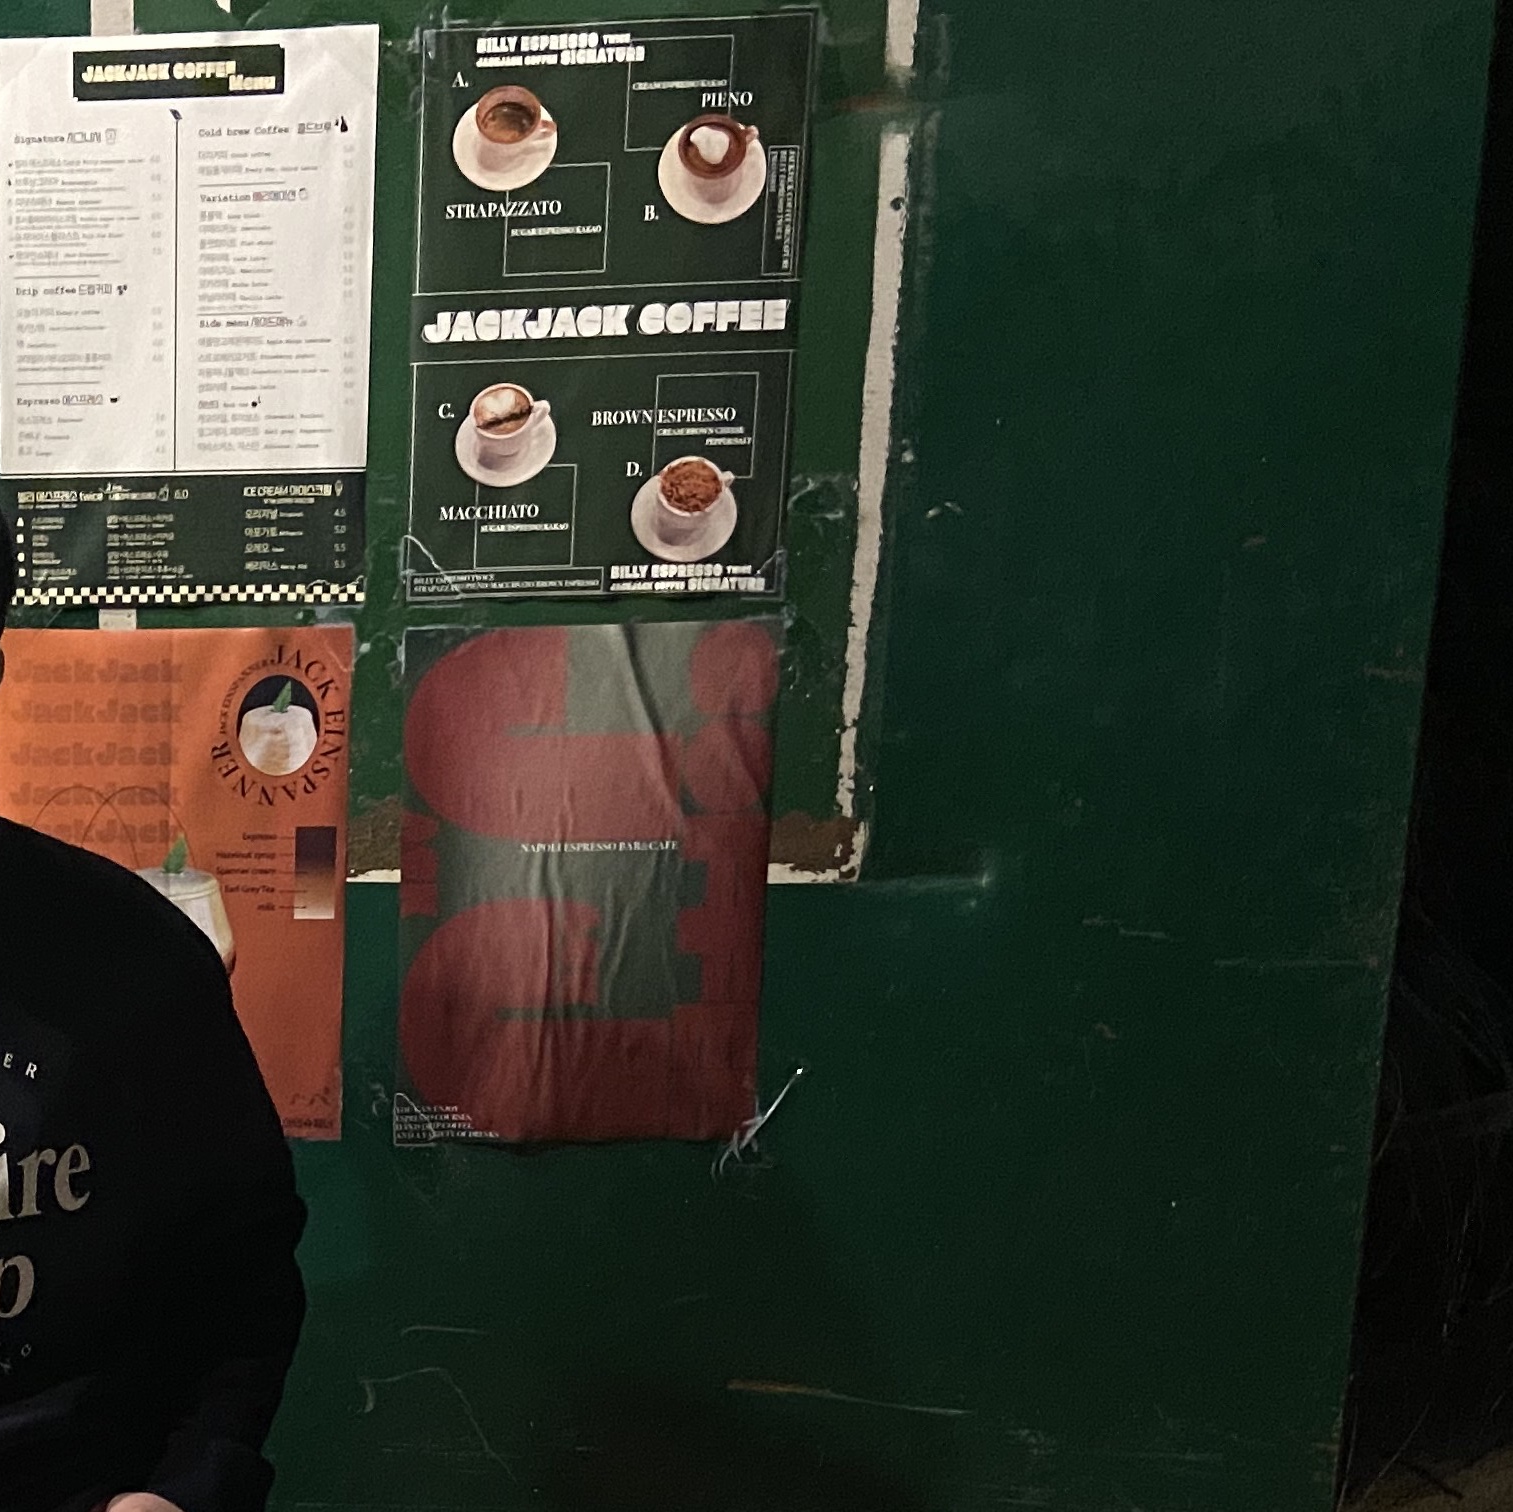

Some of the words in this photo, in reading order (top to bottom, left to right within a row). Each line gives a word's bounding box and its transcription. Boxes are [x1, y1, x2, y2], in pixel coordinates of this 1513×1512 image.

[520, 32, 599, 52] ESPRESSO
[560, 45, 645, 66] SIGNATURE
[81, 63, 170, 84] JACKJACK
[173, 60, 238, 82] COFFEE
[451, 72, 470, 88] A.
[701, 91, 754, 108] PIENO
[14, 134, 65, 146] Signature
[198, 128, 222, 138] Cold
[227, 127, 250, 137] brew
[254, 125, 290, 136] Coffee
[199, 192, 251, 203] Variation
[445, 200, 562, 220] STRAPAZZATO
[644, 204, 660, 221] B.
[15, 287, 39, 297] Drip
[43, 286, 77, 296] coffee
[199, 319, 221, 329] Side
[422, 304, 635, 344] JACKJACK
[638, 299, 791, 336] COFFEE
[16, 397, 61, 408] Espresso
[438, 403, 455, 419] C.
[591, 408, 654, 427] BROWN
[657, 406, 737, 424] ESPRESSO
[626, 461, 644, 477] D.
[439, 503, 540, 521] MACCHIATO
[610, 564, 649, 580] BILLY
[651, 563, 724, 579] ESPRESSO
[687, 576, 766, 592] SIGNATURE
[11, 658, 183, 684] JackJack
[273, 645, 339, 700] JACK
[11, 699, 183, 724] JackJack
[211, 709, 345, 806] EINSPANNER
[521, 843, 561, 853] NAPOLI
[564, 842, 617, 852] ESPRESSO
[619, 841, 639, 851] BAR
[648, 840, 678, 850] CAFE
